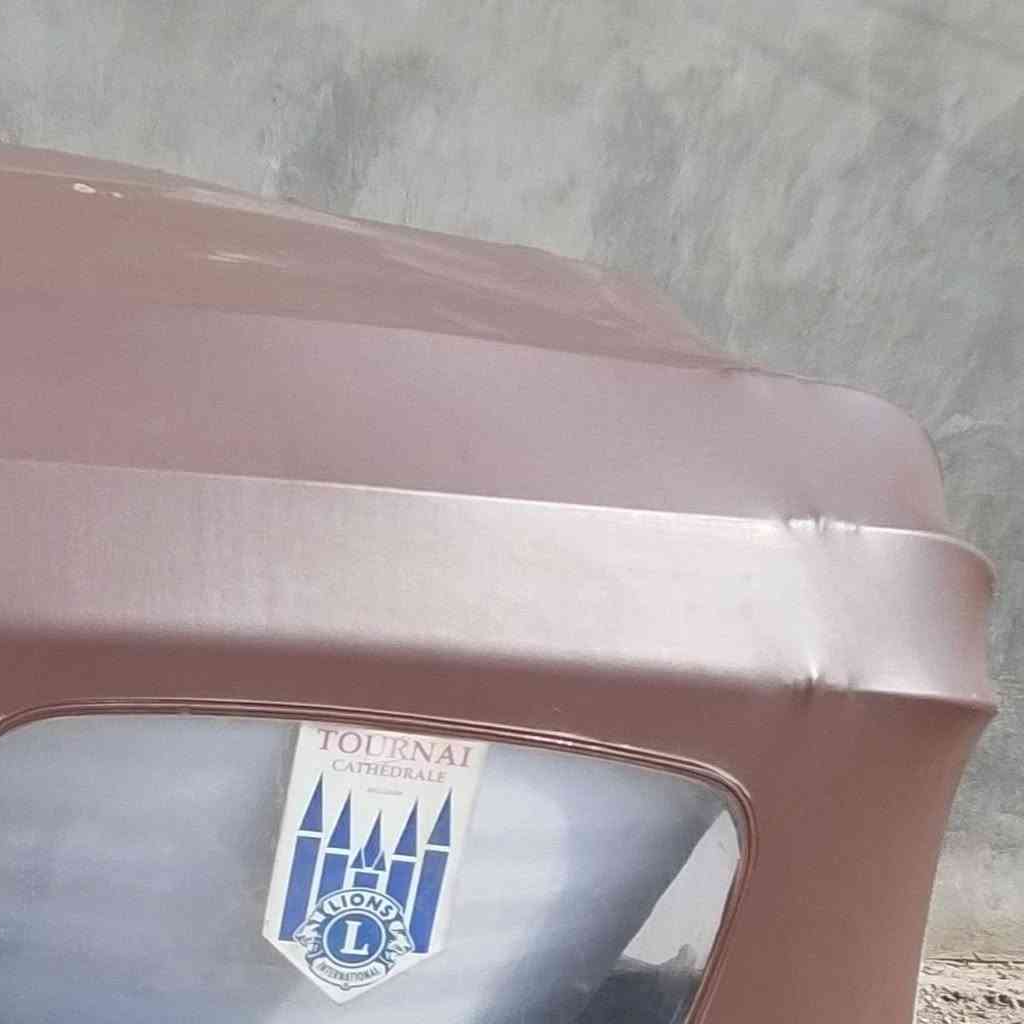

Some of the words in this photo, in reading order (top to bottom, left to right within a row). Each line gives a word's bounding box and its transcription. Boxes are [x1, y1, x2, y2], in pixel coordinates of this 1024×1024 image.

[318, 728, 473, 768] TOURNAI
[332, 758, 448, 784] CATHEDRALE
[328, 893, 394, 917] LIONS
[340, 920, 370, 956] L
